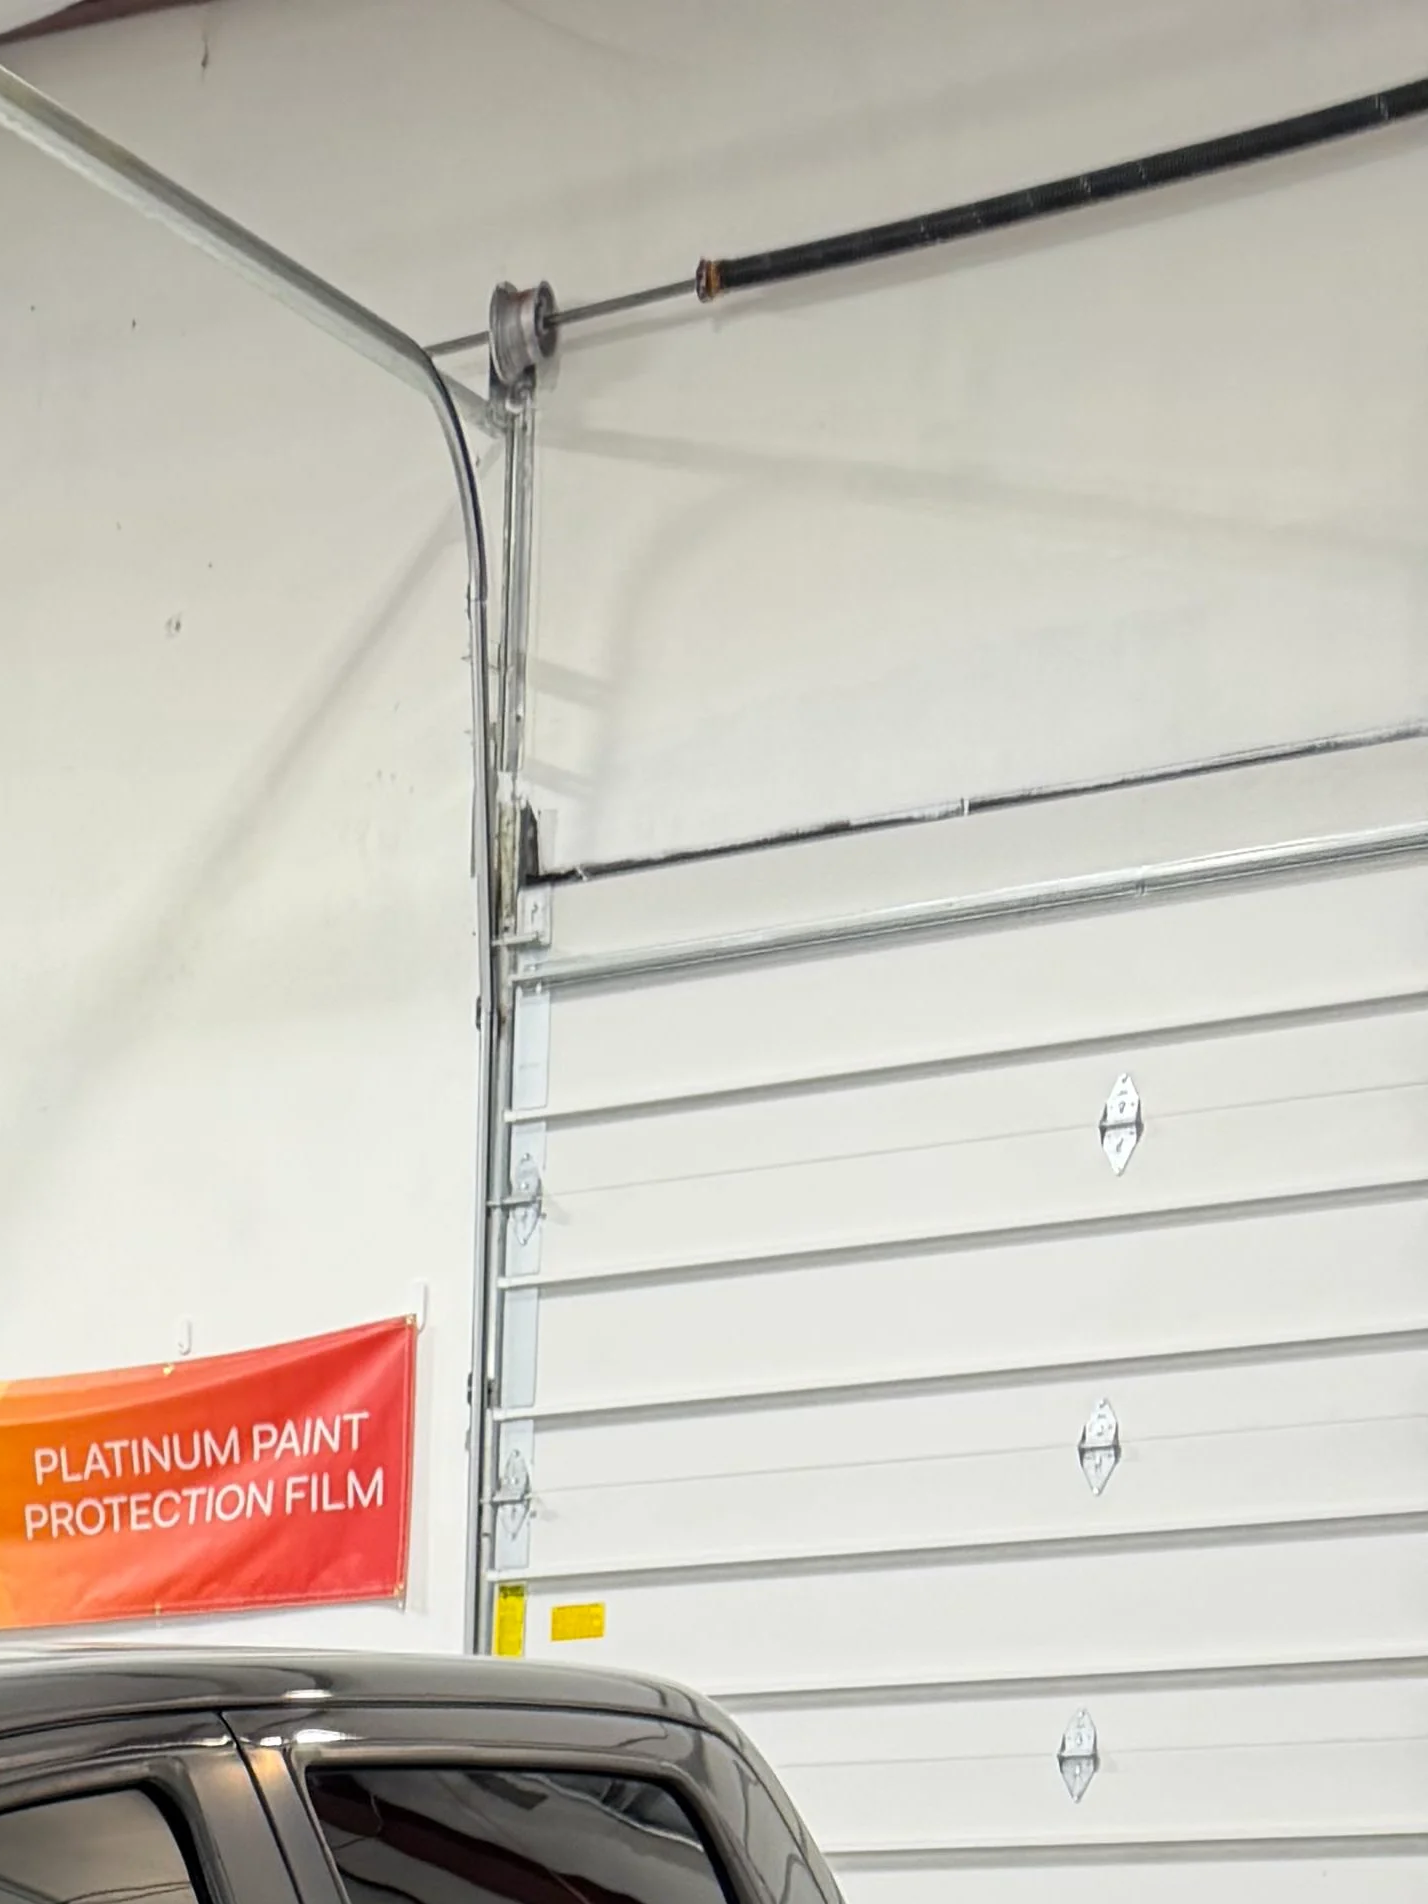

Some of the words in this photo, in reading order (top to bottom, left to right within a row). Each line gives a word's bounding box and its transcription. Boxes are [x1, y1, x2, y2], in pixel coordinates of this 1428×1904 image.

[33, 1425, 241, 1486] PLATINUM
[251, 1410, 370, 1462] PAINT
[23, 1478, 274, 1541] PROTECTION
[283, 1466, 385, 1515] FILM
